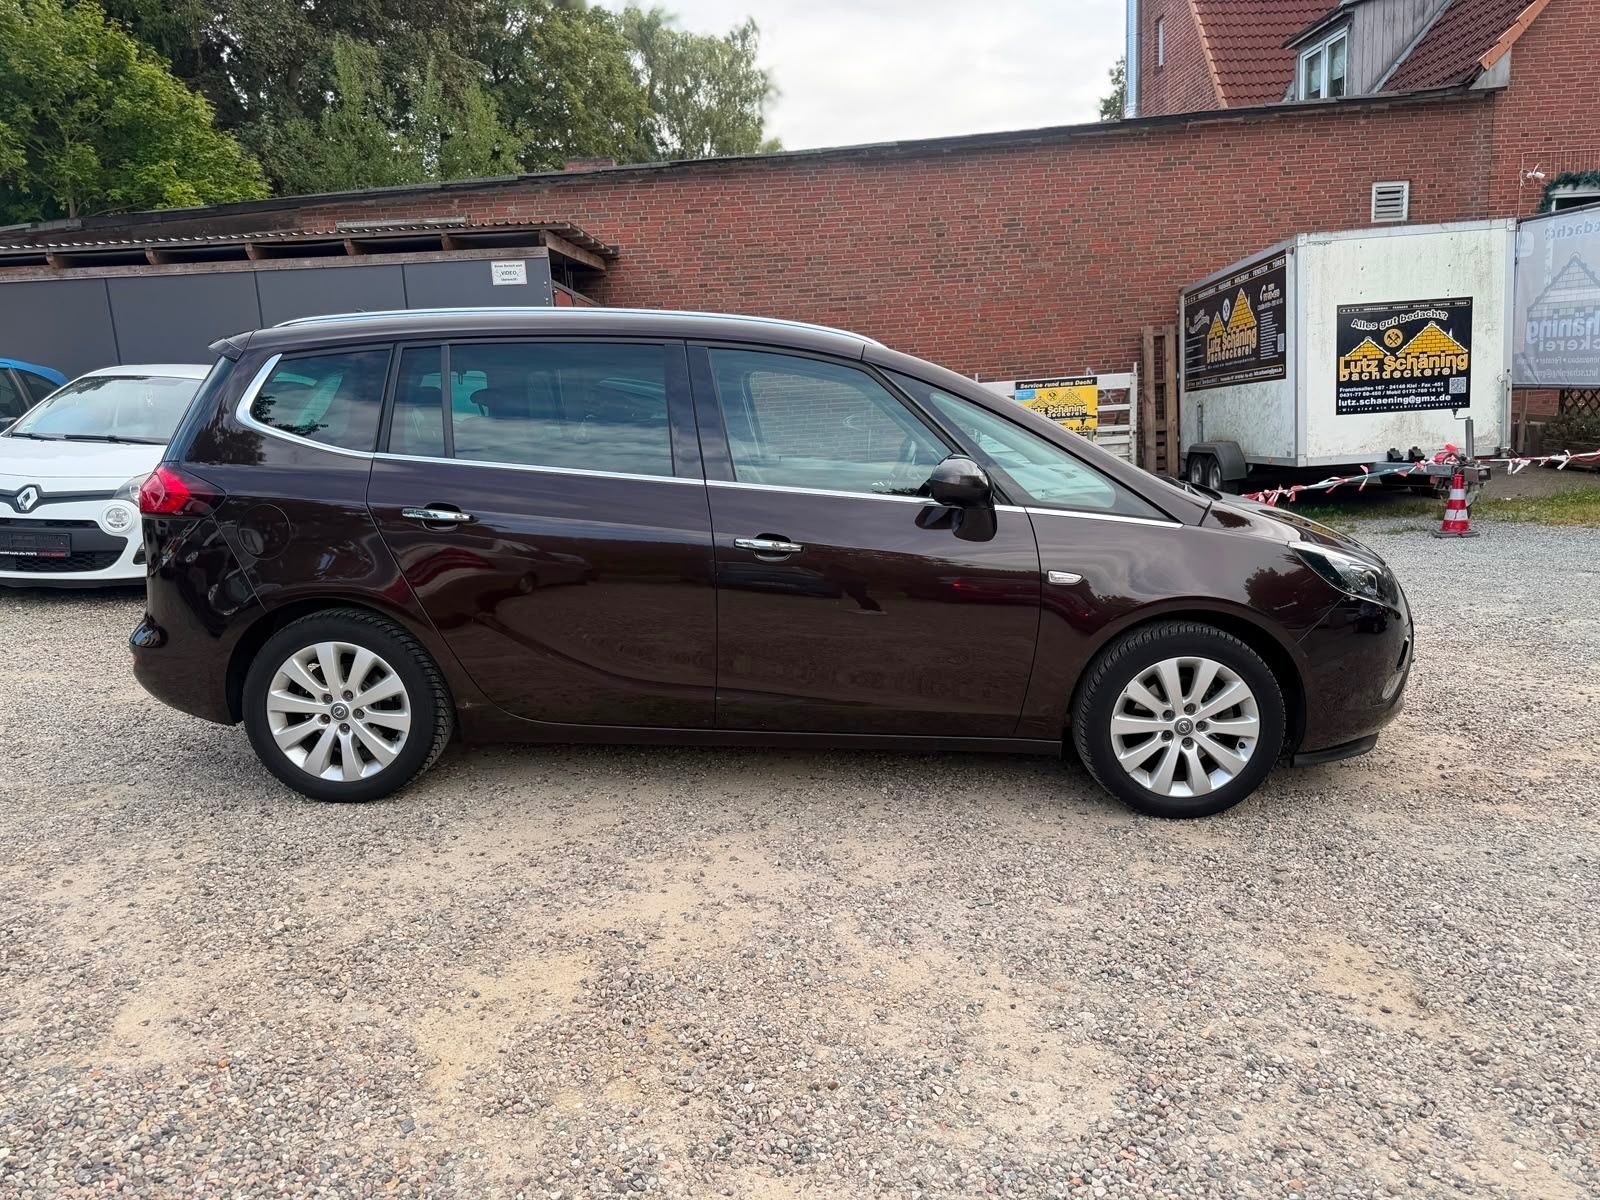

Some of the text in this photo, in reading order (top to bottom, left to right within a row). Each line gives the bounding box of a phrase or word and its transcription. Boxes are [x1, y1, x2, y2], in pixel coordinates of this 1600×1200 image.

[1351, 309, 1448, 330] Alles gut bedacht?
[1339, 353, 1469, 373] Lutz Schäning
[1339, 366, 1457, 381] Dachdeckerei
[1338, 394, 1451, 407] lutz.schaening@gmx.de
